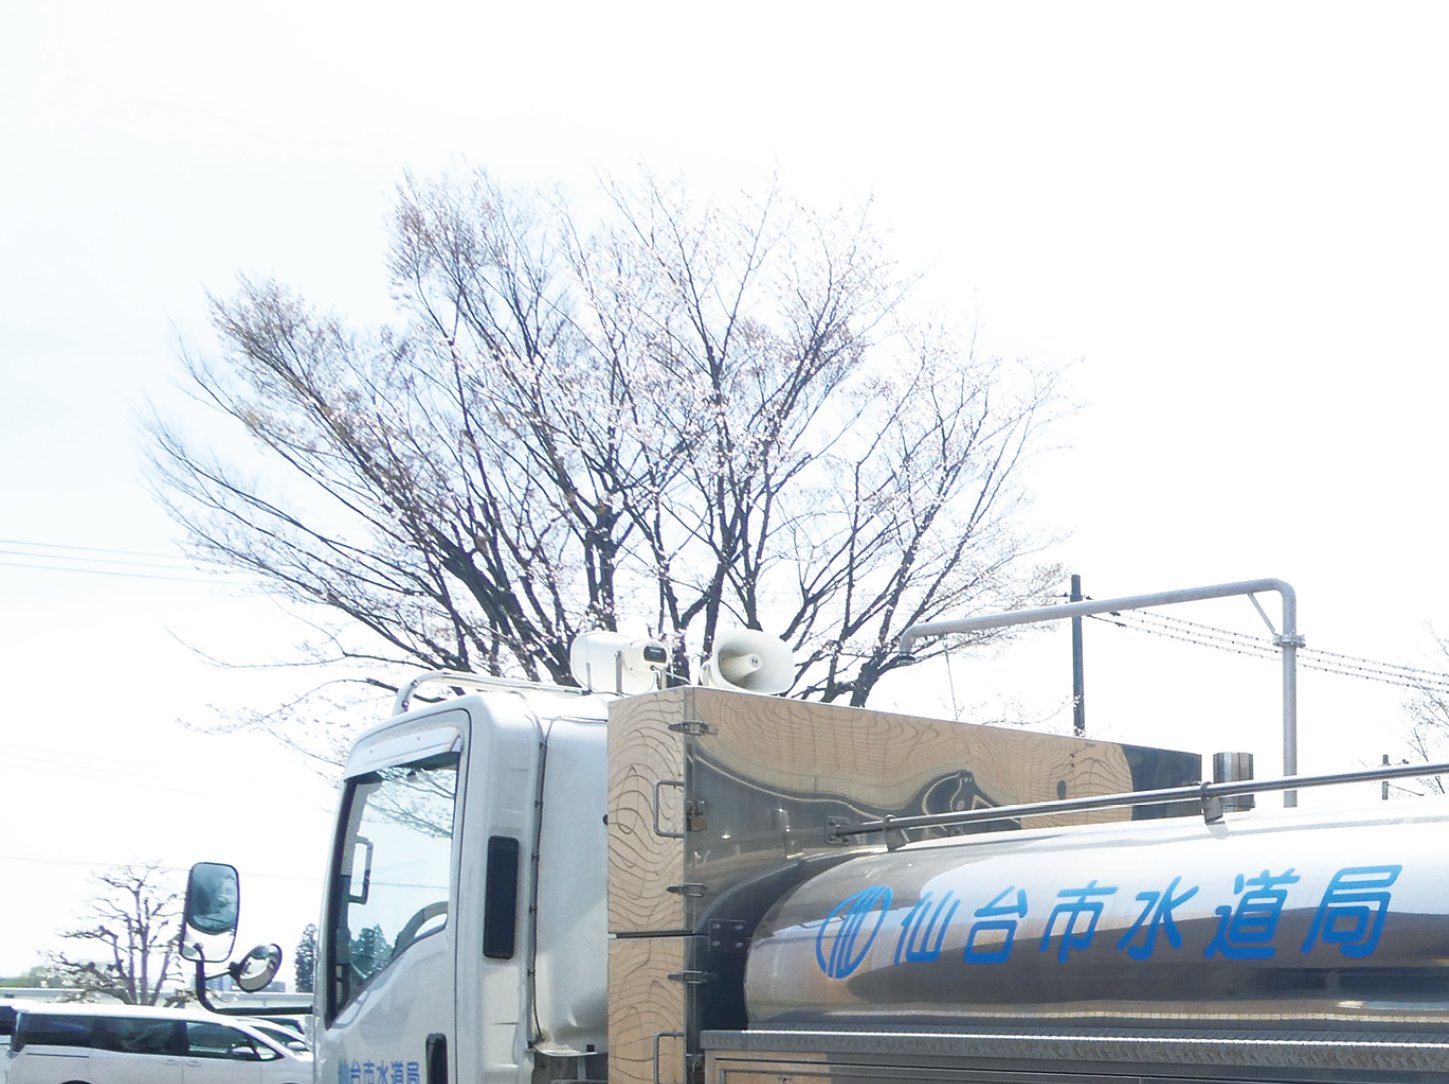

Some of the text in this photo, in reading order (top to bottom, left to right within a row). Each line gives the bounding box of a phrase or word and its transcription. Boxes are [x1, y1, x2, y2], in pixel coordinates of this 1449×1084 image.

[893, 864, 1403, 966] 仙台市水道局
